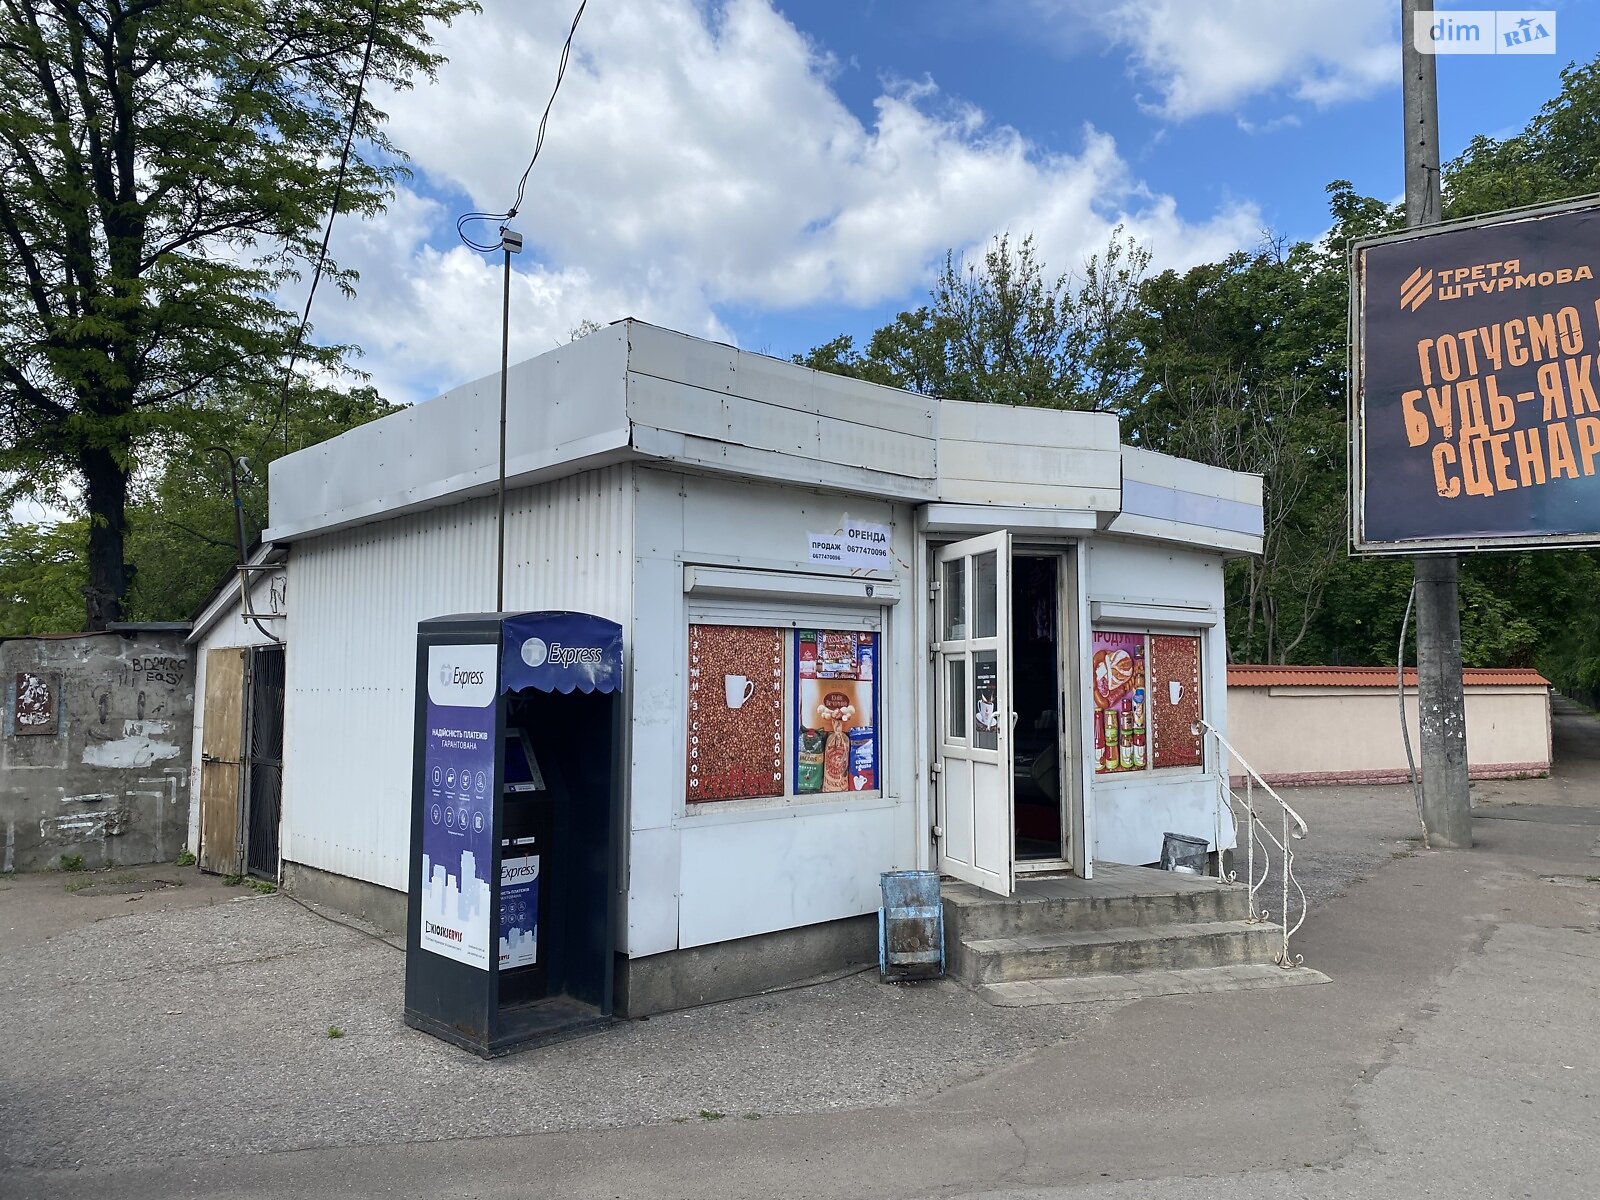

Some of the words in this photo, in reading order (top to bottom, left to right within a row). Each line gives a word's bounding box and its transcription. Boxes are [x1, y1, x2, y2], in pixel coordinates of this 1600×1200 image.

[1438, 259, 1521, 285] ТРЕТЯ
[1438, 265, 1594, 301] ШТУРМОВА
[1417, 306, 1584, 386] ГОТУЄМО
[1401, 352, 1600, 448] БУДЬ-ЯК
[848, 528, 886, 543] ОРЕНДА
[812, 541, 841, 551] ПРОДАЖ
[847, 545, 887, 557] 0677470096
[812, 553, 841, 561] 0677470096
[548, 643, 602, 668] Express
[453, 666, 484, 689] Express
[463, 730, 488, 740] ПЛАТЕЖІВ
[441, 739, 478, 750] ГАРАНТОВАНА
[501, 865, 535, 881] Express
